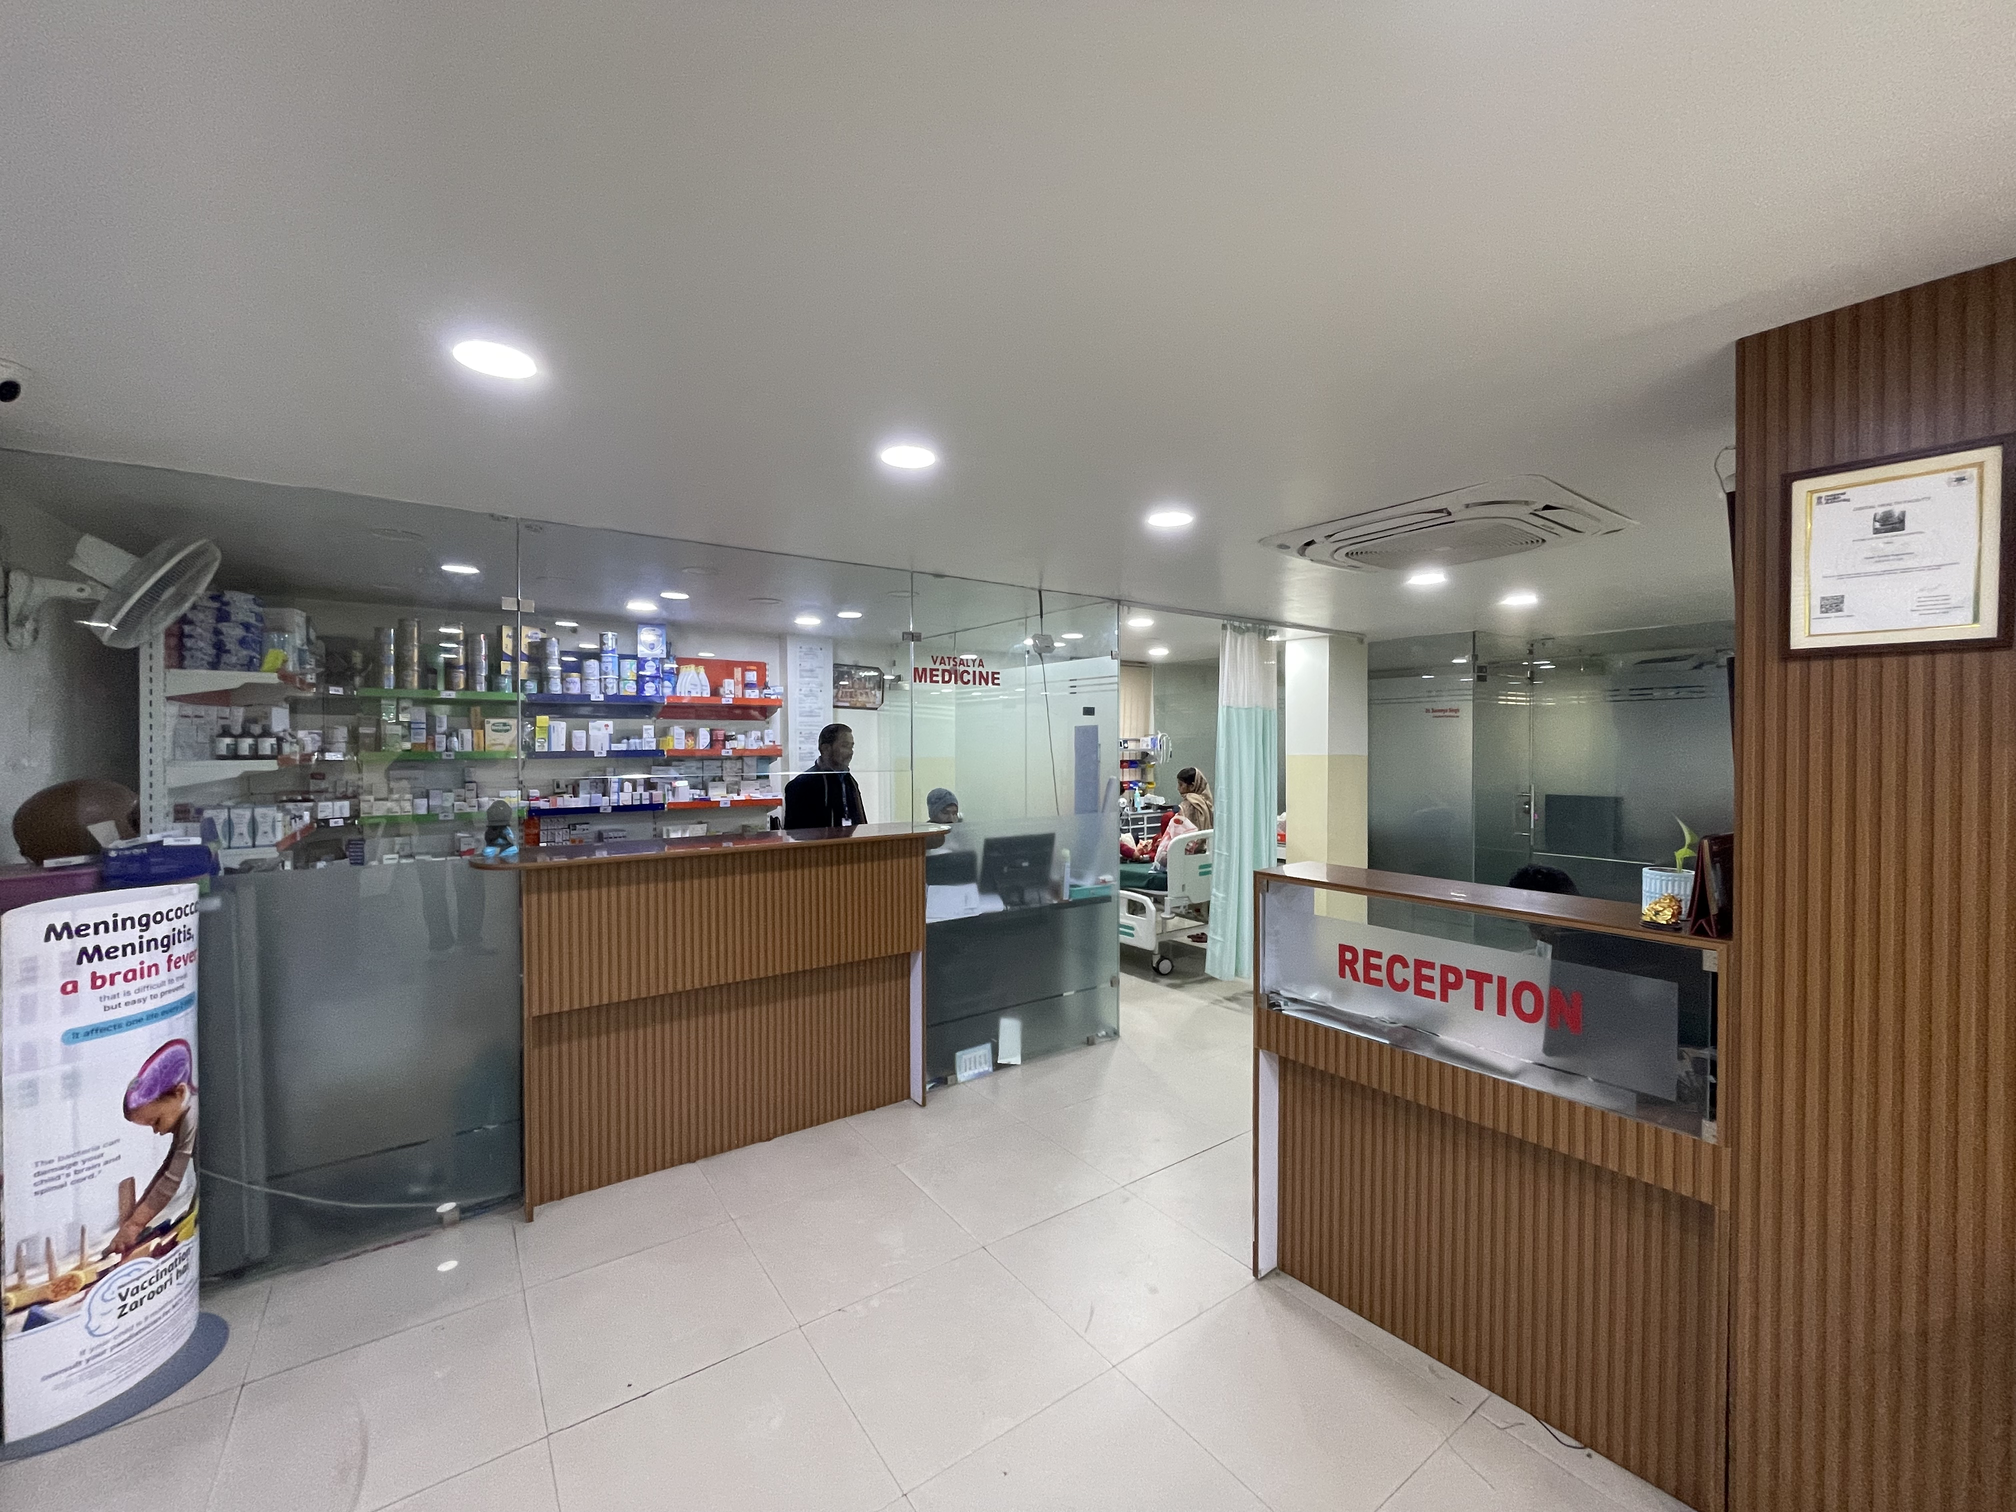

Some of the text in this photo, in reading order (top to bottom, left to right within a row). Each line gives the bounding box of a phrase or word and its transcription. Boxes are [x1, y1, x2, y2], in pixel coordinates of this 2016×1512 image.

[931, 655, 984, 668] VATSALYA
[913, 667, 1000, 686] MEDICINE
[76, 925, 194, 965] Meningitis,
[60, 979, 79, 995] a
[90, 960, 159, 991] brain
[99, 992, 120, 1002] that
[134, 979, 166, 994] difficult
[1338, 943, 1583, 1036] RECEPTION
[103, 1002, 121, 1012] but
[124, 996, 147, 1007] easy
[83, 1022, 123, 1037] affects
[125, 1017, 143, 1027] one
[34, 1138, 120, 1168] The bacteria can
[33, 1152, 104, 1178] damage your
[74, 1163, 101, 1176] brain
[103, 1154, 121, 1166] and
[34, 1181, 67, 1196] spinal
[117, 1273, 172, 1319] Zaroori
